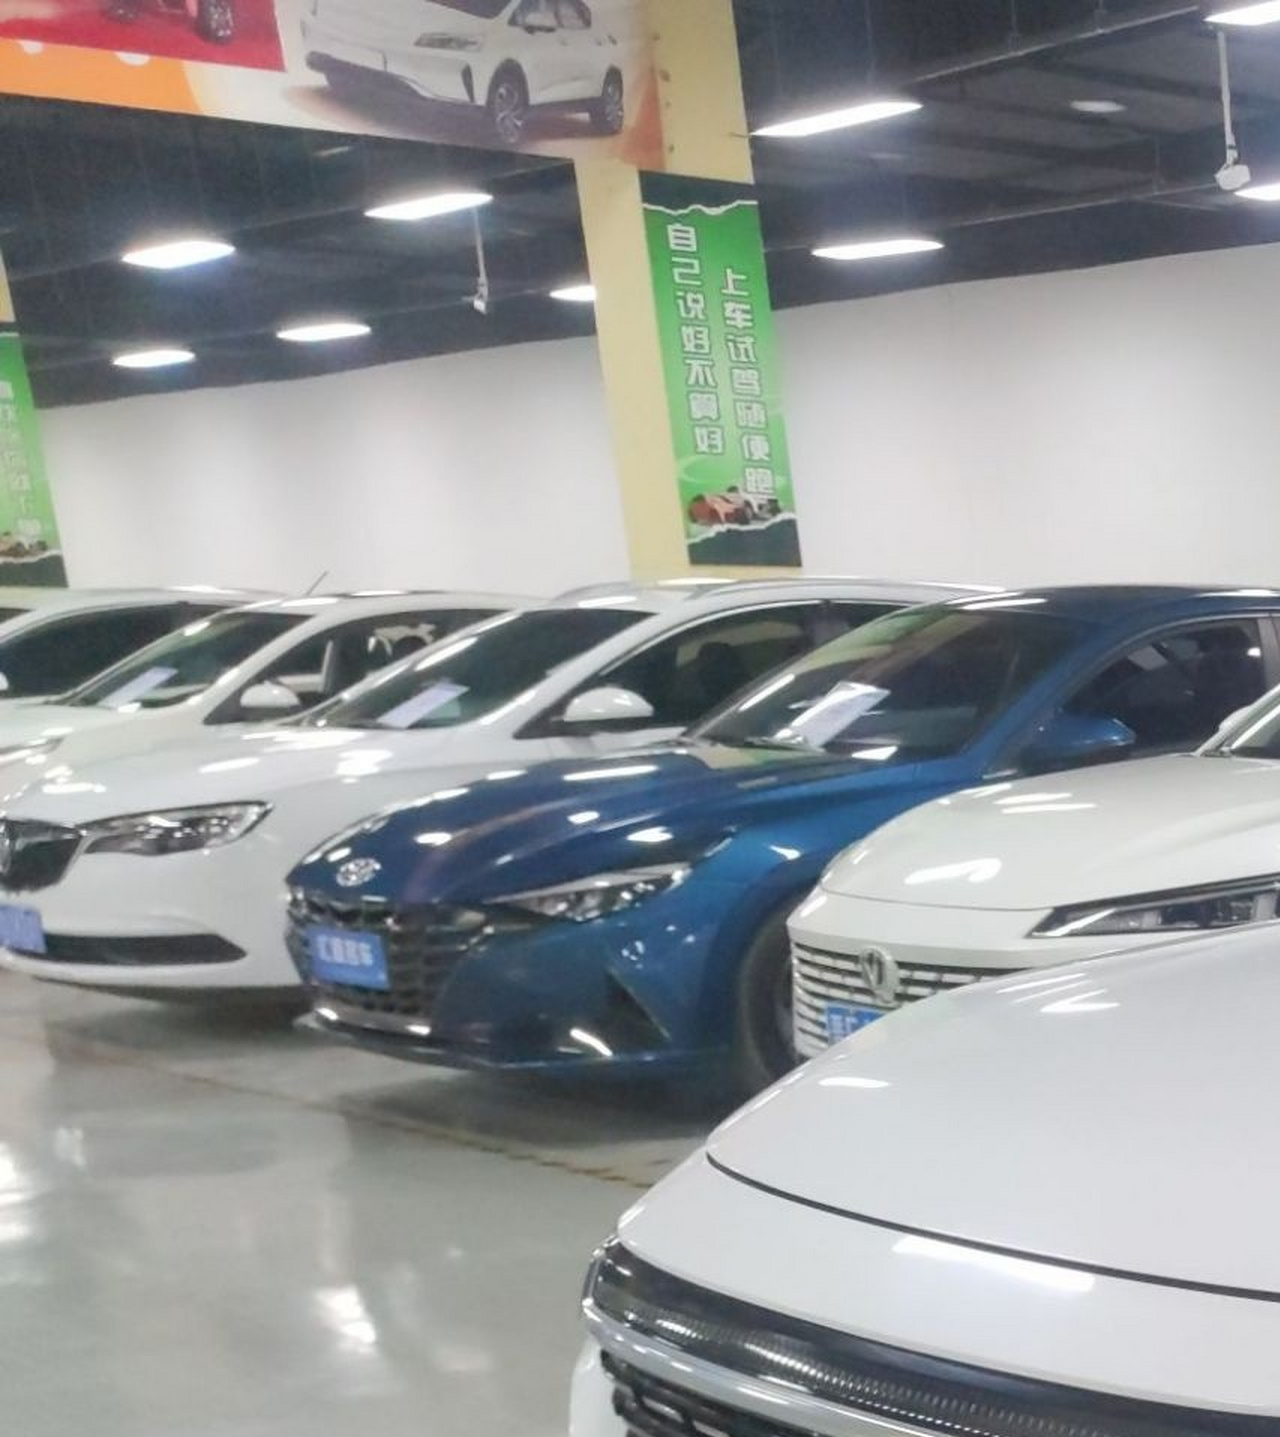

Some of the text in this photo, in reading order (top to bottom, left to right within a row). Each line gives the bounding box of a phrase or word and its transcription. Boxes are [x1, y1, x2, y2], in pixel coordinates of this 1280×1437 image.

[667, 222, 724, 454] 自己说好不算好
[721, 267, 774, 496] 上车试驾随便跑
